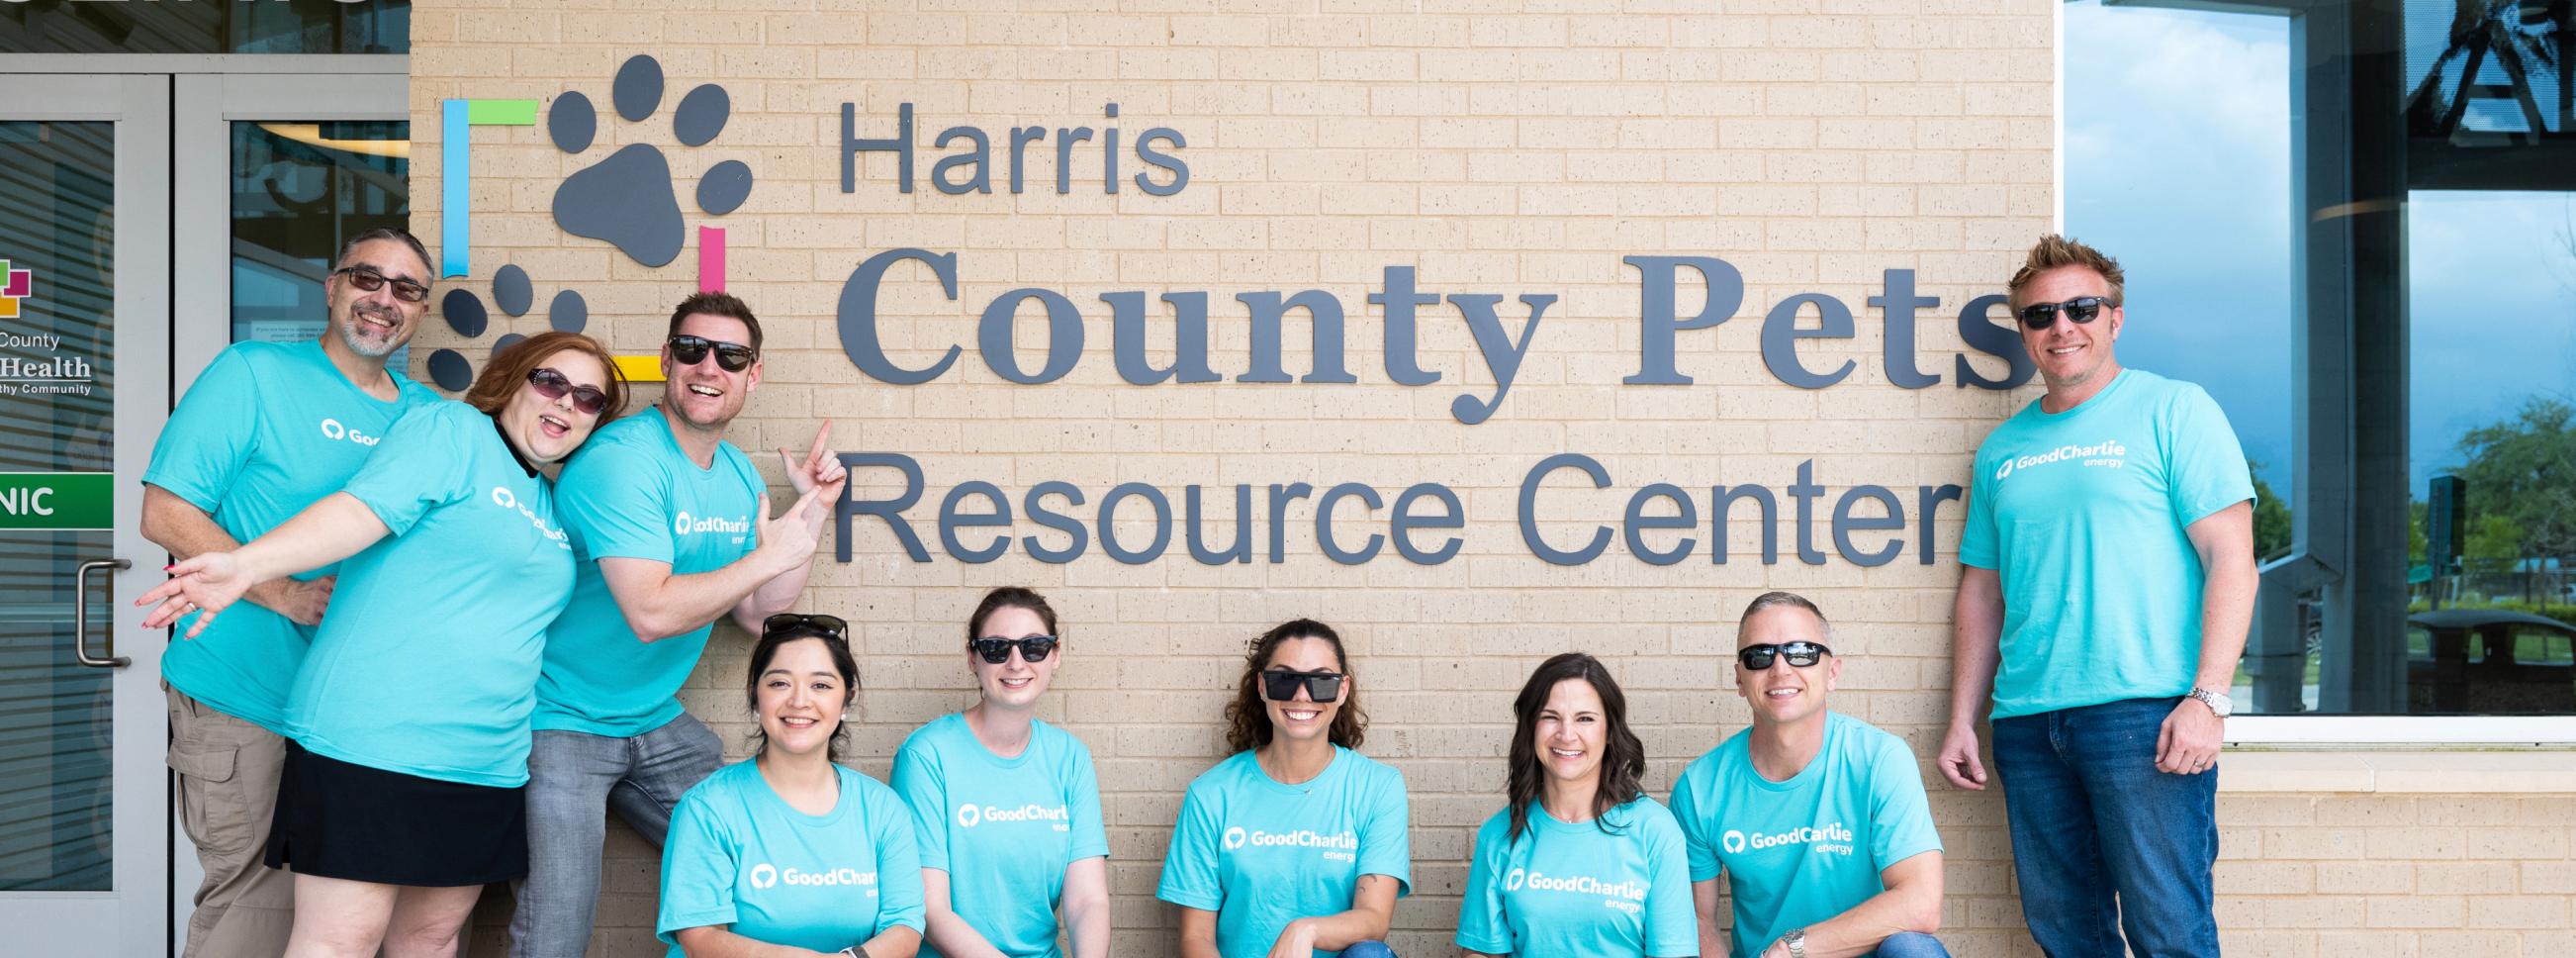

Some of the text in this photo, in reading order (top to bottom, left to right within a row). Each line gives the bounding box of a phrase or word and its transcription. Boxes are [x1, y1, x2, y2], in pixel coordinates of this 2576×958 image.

[841, 102, 1190, 196] Harris
[0, 332, 60, 351] County
[837, 247, 2038, 425] County Pets
[1, 356, 92, 378] Health
[22, 383, 92, 397] Community
[2016, 439, 2126, 470] GoodCharlie
[2083, 457, 2125, 468] energy
[0, 487, 54, 516] NIC
[835, 452, 1963, 566] Resource Center
[1323, 850, 1356, 864] energ
[1815, 842, 1854, 856] energy
[1527, 872, 1645, 901] GoodCharlie
[1605, 899, 1640, 913] energy
